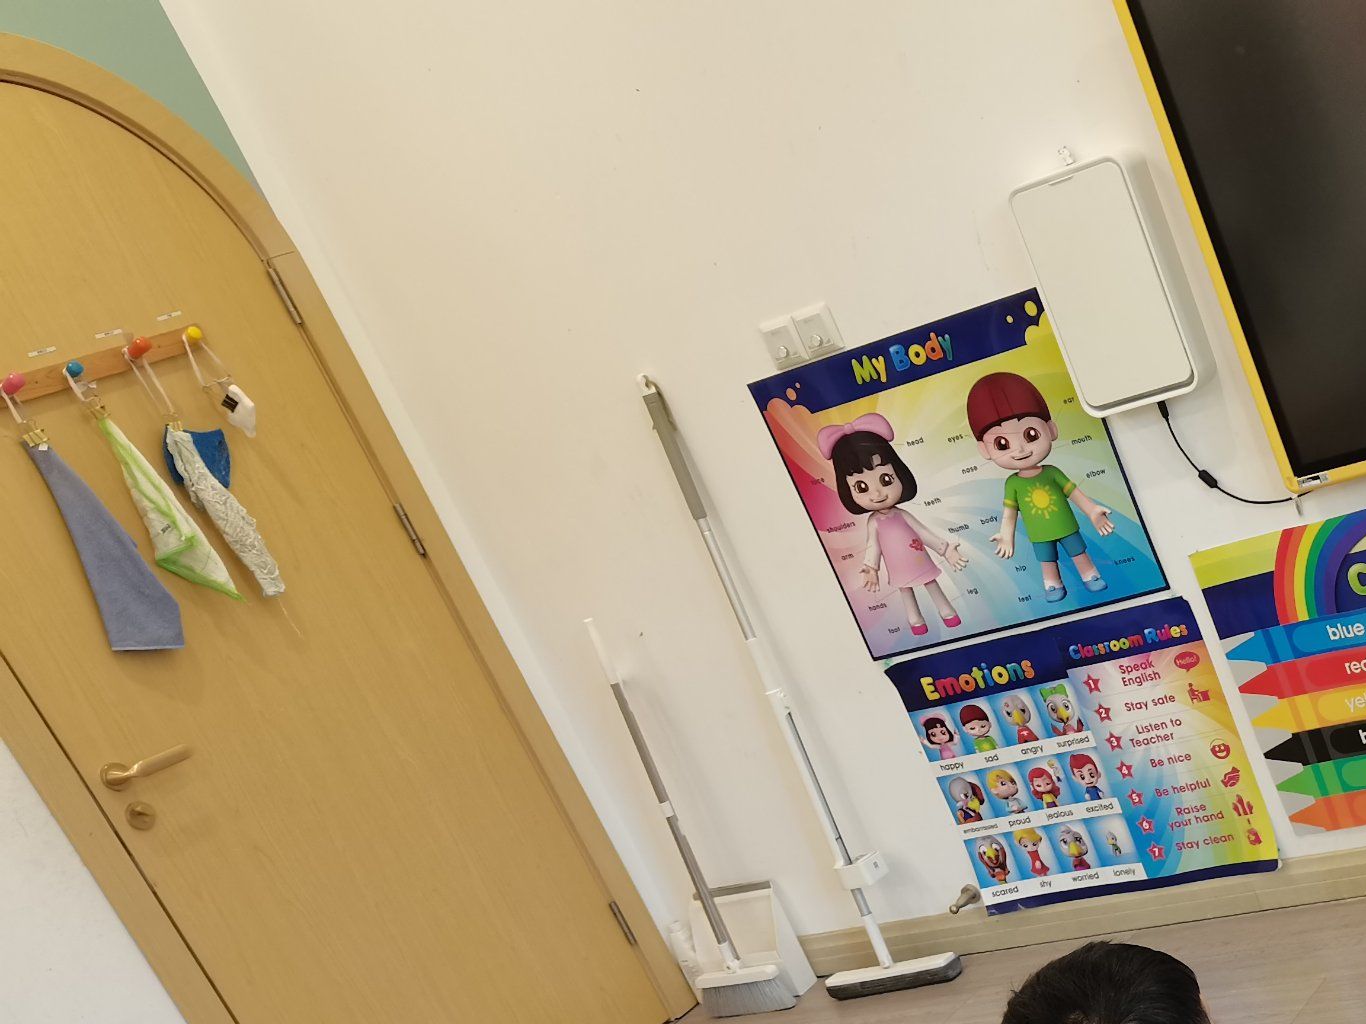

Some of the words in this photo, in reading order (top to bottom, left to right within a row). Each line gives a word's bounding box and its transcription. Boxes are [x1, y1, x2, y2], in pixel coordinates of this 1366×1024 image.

[851, 355, 887, 385] My
[889, 332, 953, 371] Body
[906, 437, 924, 447] head
[947, 434, 964, 443] eyes
[1071, 435, 1092, 445] mouth
[961, 465, 978, 475] nose
[1085, 468, 1106, 479] elbow
[980, 515, 998, 525] body
[826, 521, 856, 534] shoulders
[948, 523, 970, 534] thumb
[841, 553, 854, 561] arm
[1114, 556, 1135, 566] knees
[1015, 564, 1027, 573] hip
[1326, 623, 1365, 640] blue
[1068, 634, 1144, 660] Classroom
[1144, 624, 1188, 643] Rules
[1118, 660, 1155, 675] Speak
[919, 660, 1035, 701] Emotions
[1088, 679, 1095, 689] 1
[1121, 670, 1161, 687] English
[1100, 708, 1107, 718] 2
[1124, 701, 1148, 712] Stay
[1151, 694, 1176, 705] safe
[1135, 720, 1168, 735] Listen
[1170, 718, 1182, 727] to
[1056, 735, 1090, 748] surprised
[1110, 737, 1117, 747] 3
[1129, 732, 1174, 748] Teacher
[1020, 745, 1043, 756] angry
[984, 754, 999, 763] sad
[1121, 765, 1128, 775] 4
[1150, 758, 1164, 768] Be
[1167, 752, 1192, 764] nice
[939, 761, 964, 773] happy
[1131, 793, 1139, 802] 5
[1154, 788, 1168, 797] Be
[1171, 778, 1211, 794] helpful
[1085, 803, 1114, 814] excited
[1175, 803, 1207, 816] Raise
[1045, 809, 1074, 821] jealous
[1008, 817, 1031, 828] proud
[1168, 820, 1192, 831] your
[1195, 811, 1225, 823] hand
[1175, 840, 1199, 851] Stay
[1202, 833, 1234, 846] clean
[1071, 872, 1100, 882] worried
[1112, 867, 1136, 878] lonely
[1039, 879, 1052, 889] shy
[991, 886, 1019, 897] scared
